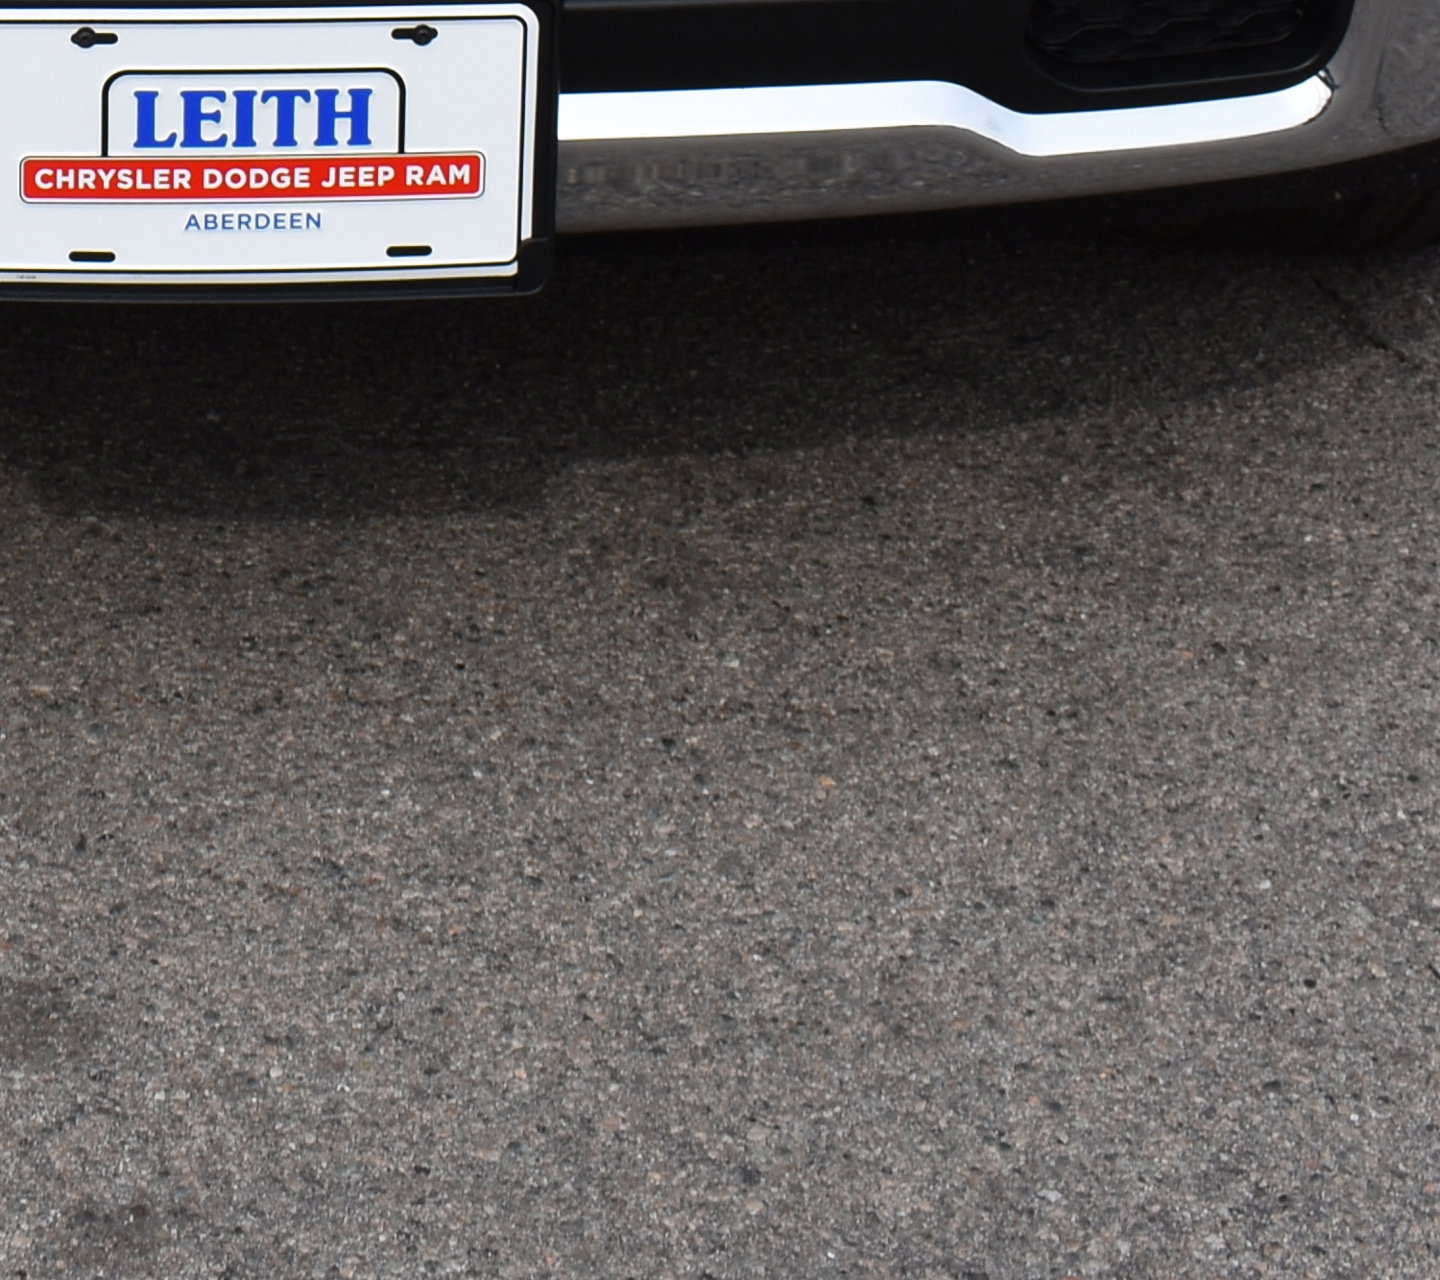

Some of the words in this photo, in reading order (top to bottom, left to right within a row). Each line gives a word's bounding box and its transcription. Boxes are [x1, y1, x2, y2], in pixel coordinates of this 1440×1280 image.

[133, 88, 373, 148] LEITH
[34, 168, 191, 190] CHRYSLER
[203, 167, 311, 190] DODGE
[321, 165, 395, 188] JEEP
[405, 163, 471, 187] RAM
[184, 212, 322, 231] ABERDEEN
